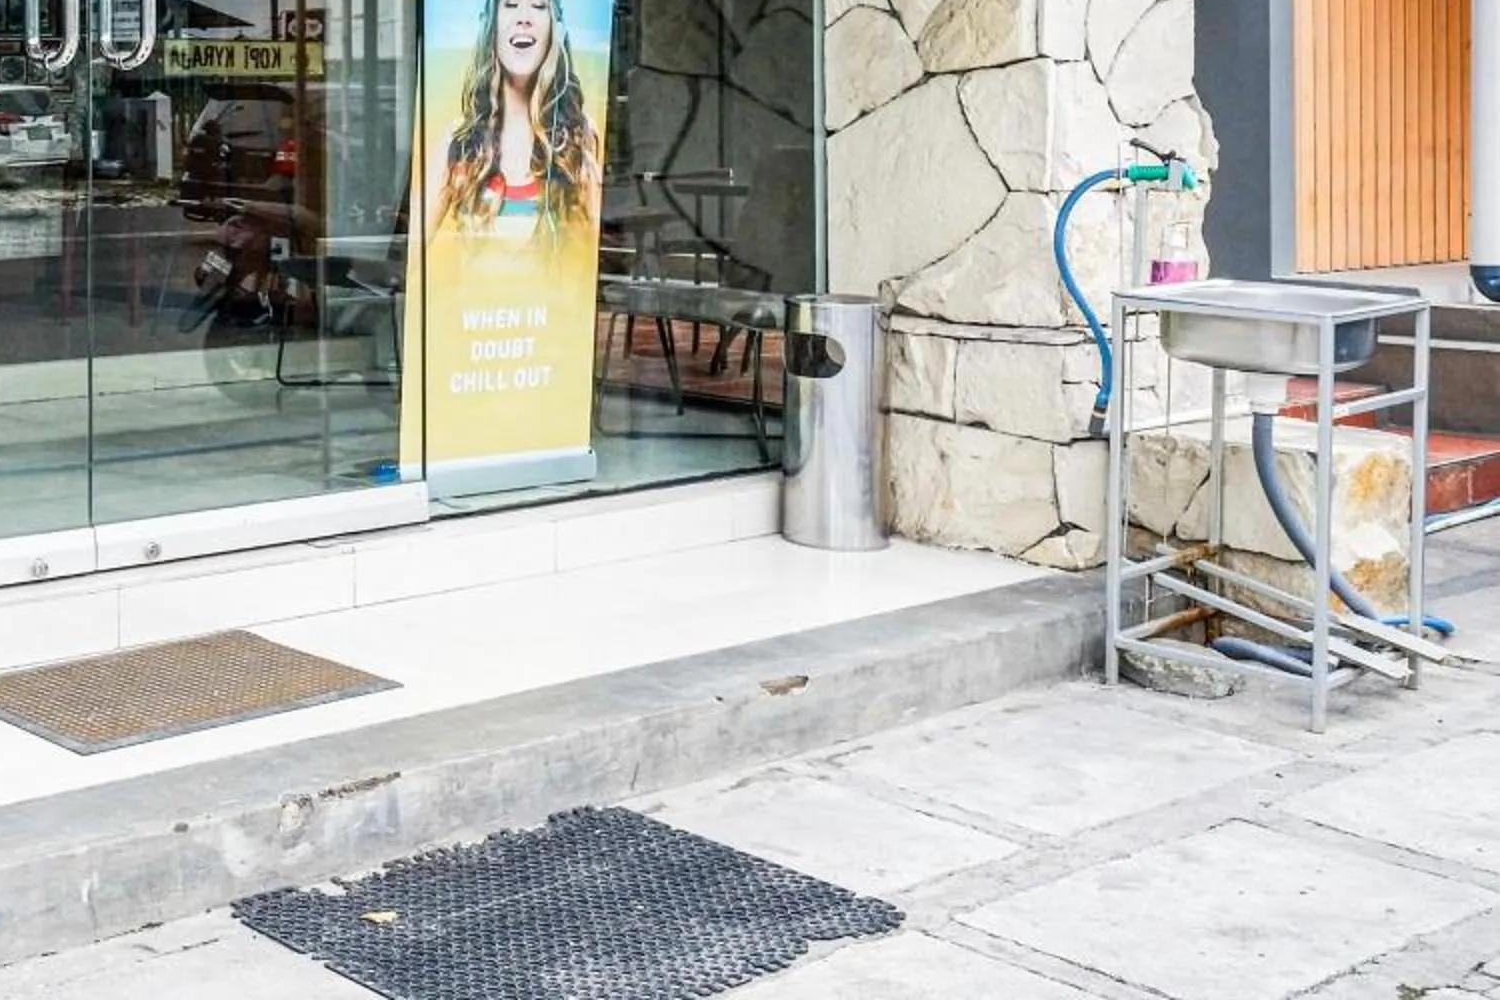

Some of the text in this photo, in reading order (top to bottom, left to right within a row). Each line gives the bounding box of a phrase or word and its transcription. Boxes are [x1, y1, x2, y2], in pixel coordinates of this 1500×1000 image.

[463, 305, 547, 331] WHEN IN
[471, 337, 535, 361] DOUBT
[450, 365, 552, 393] CHILL OUT
